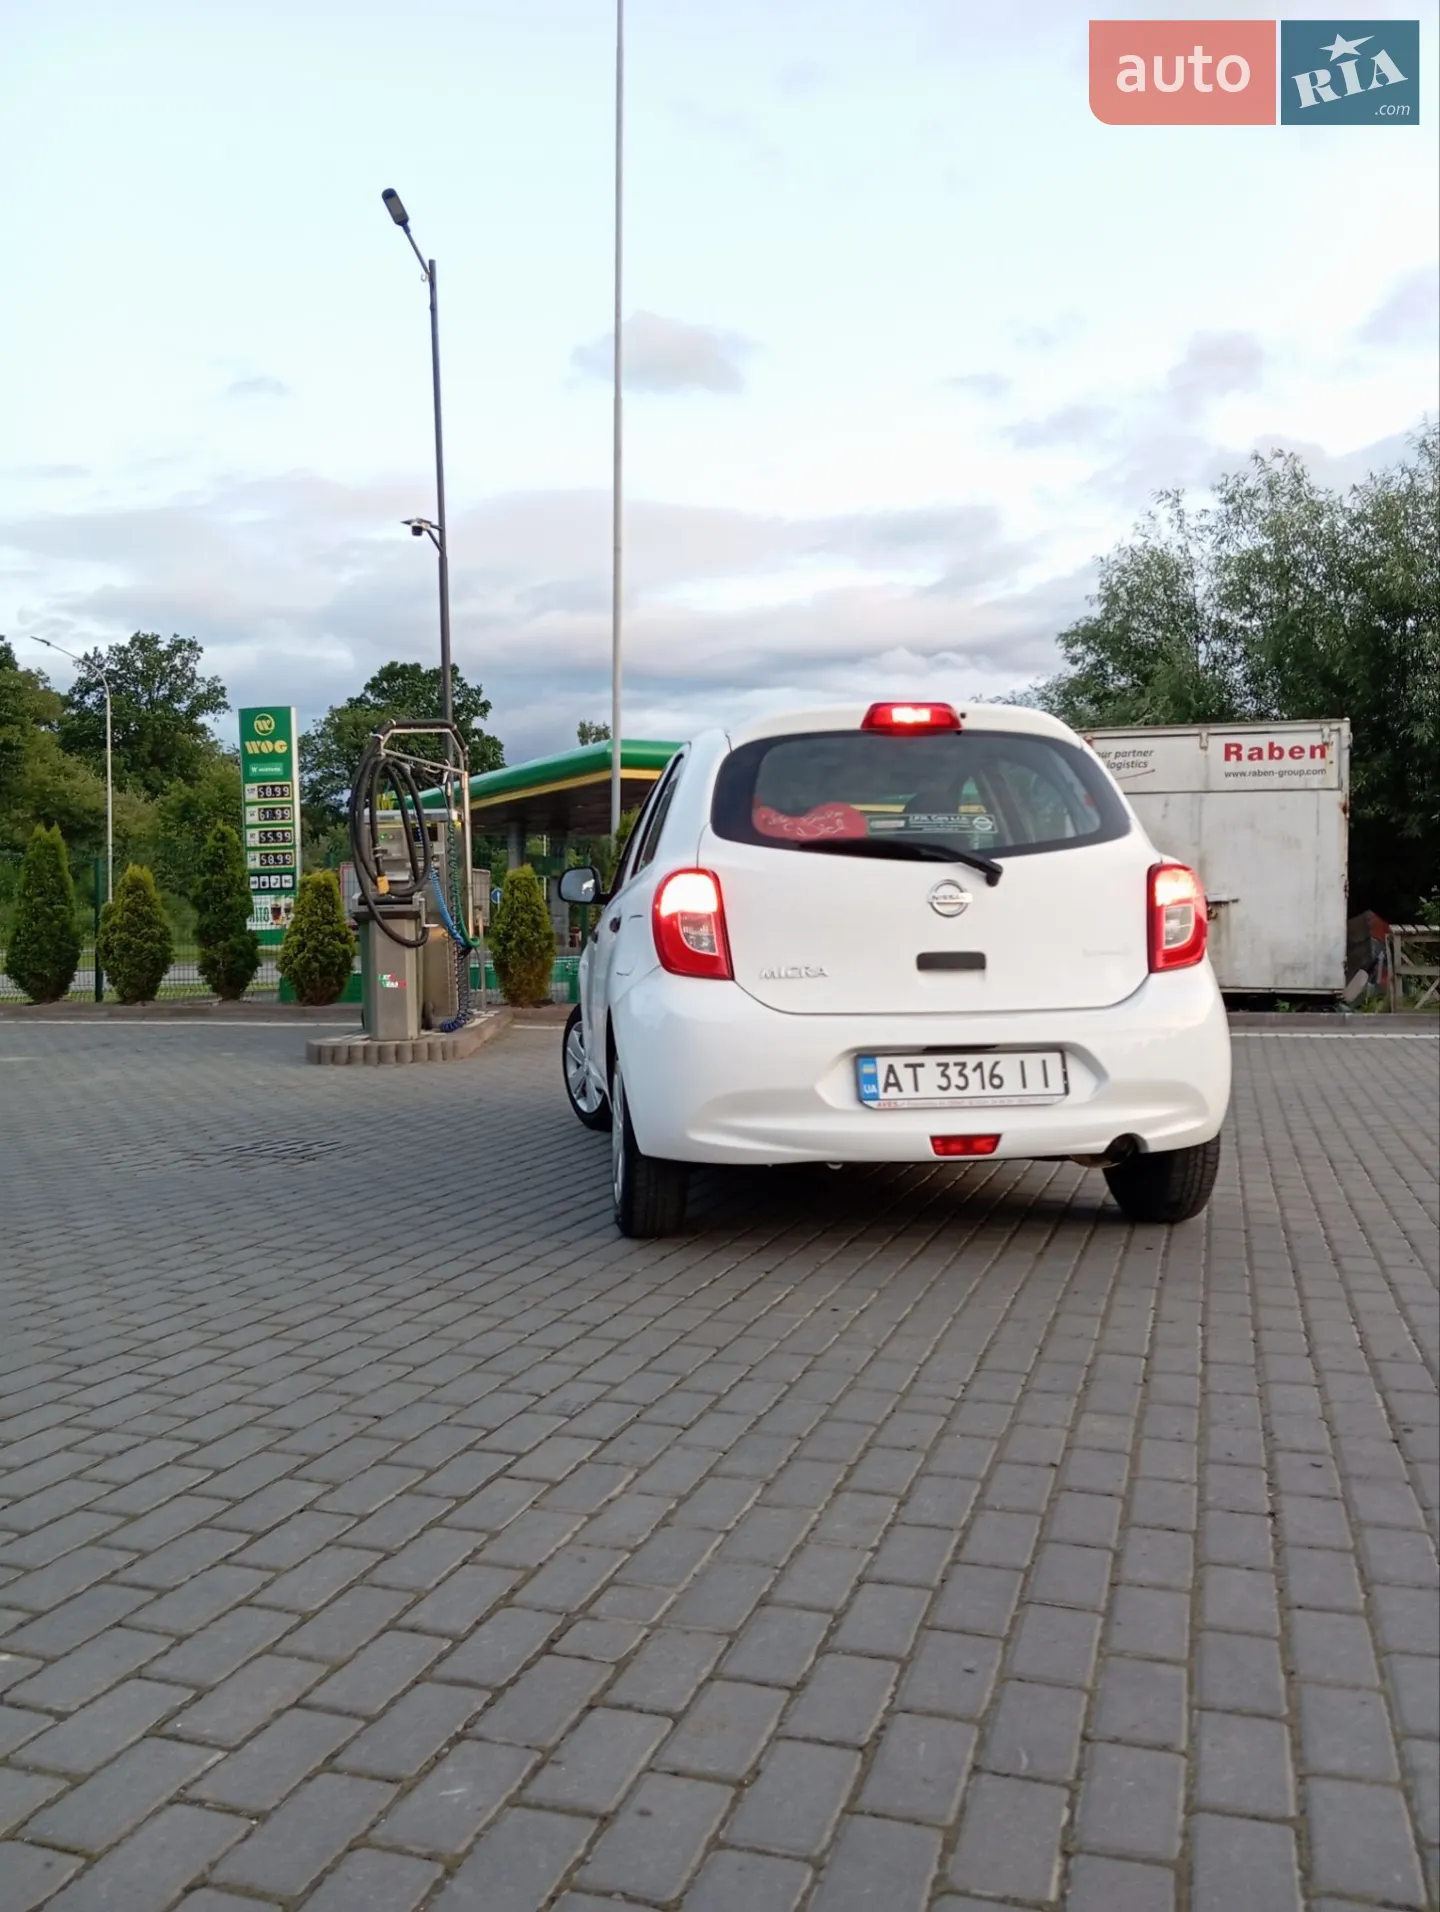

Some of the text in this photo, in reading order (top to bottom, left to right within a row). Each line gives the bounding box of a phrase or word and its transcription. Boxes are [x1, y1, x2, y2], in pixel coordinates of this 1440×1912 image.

[244, 740, 288, 754] WOG
[1224, 741, 1327, 762] Raben
[1096, 749, 1154, 760] our partner
[1106, 760, 1148, 771] logistics
[1224, 767, 1327, 778] www.raben-group.com
[760, 966, 828, 979] MICRA
[883, 1062, 925, 1093] AT
[936, 1060, 1004, 1092] 3316
[863, 1084, 878, 1094] UA
